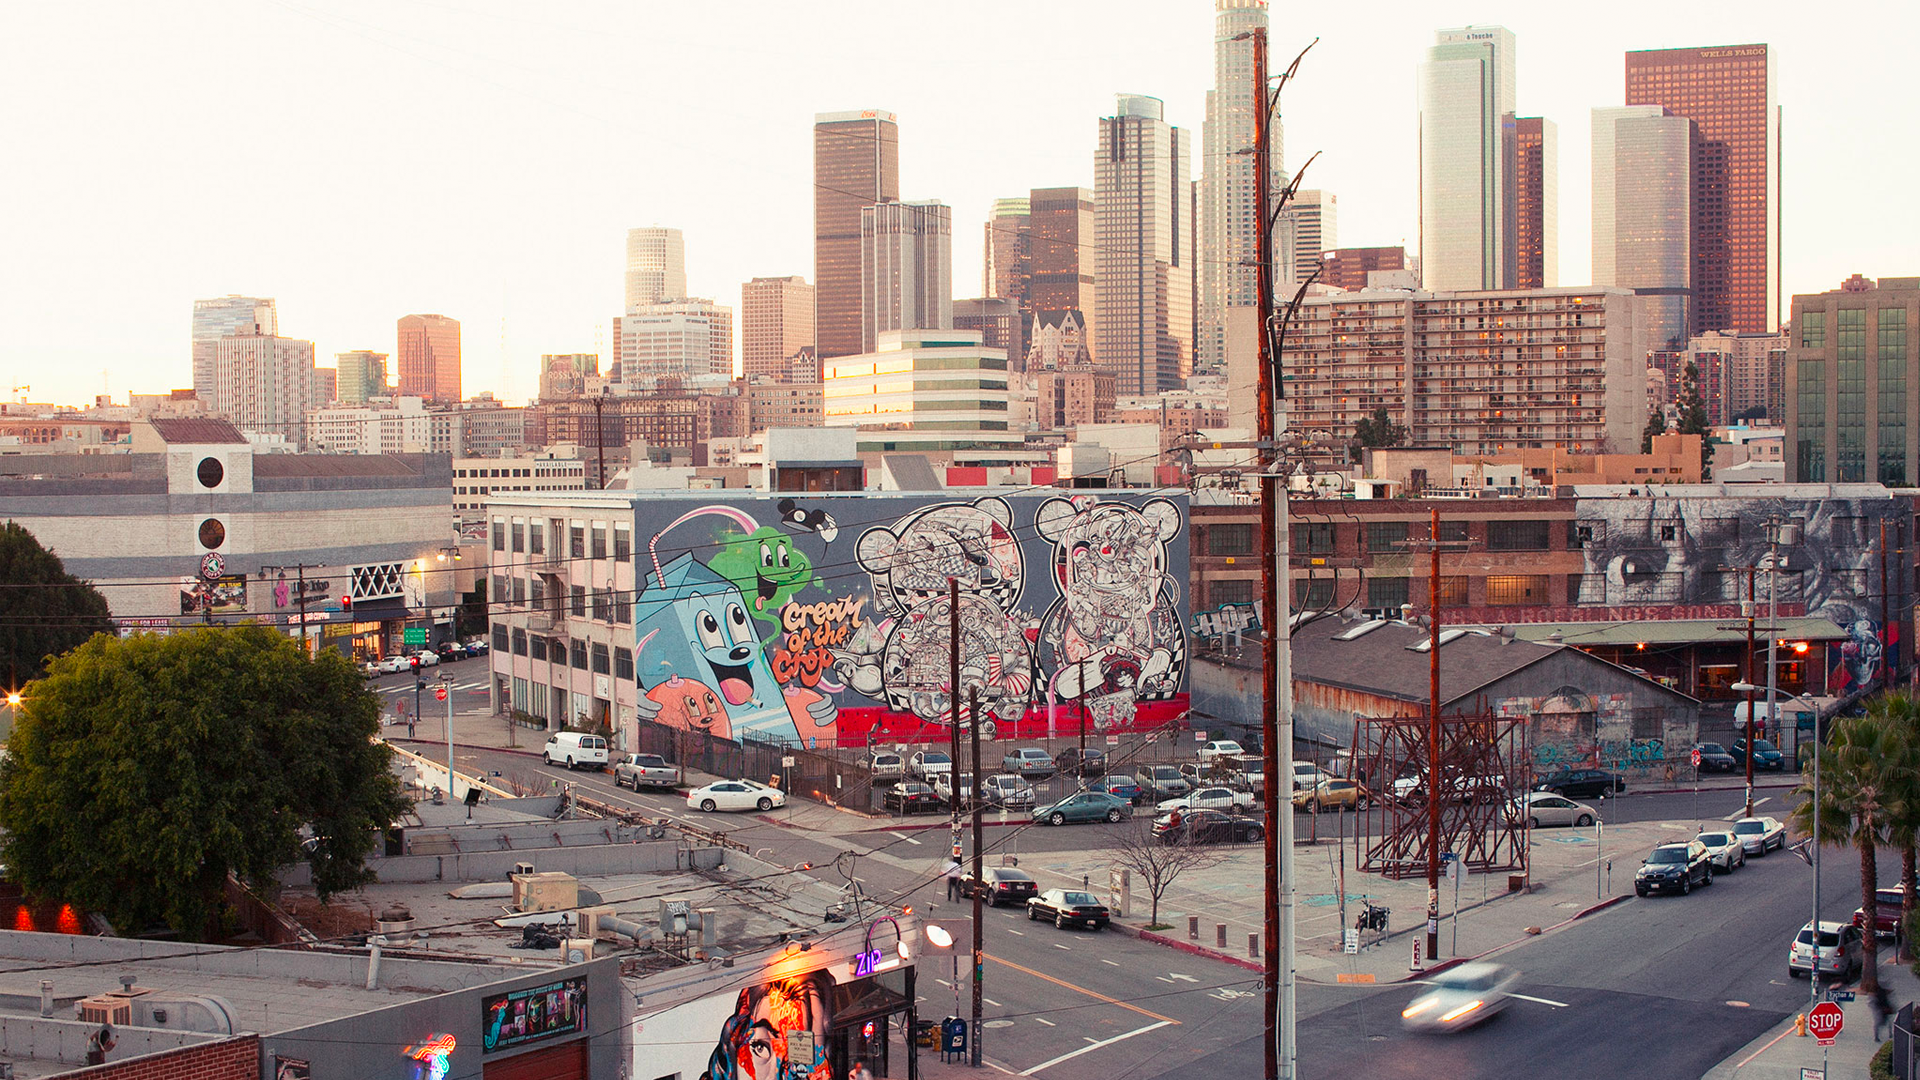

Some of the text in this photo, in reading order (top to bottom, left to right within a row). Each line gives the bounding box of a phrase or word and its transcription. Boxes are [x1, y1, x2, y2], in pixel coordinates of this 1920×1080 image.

[1700, 48, 1766, 58] WELLS FARGO
[548, 371, 581, 379] ROSSLYN
[812, 620, 848, 647] the
[855, 948, 883, 977] ZIP
[1811, 1013, 1842, 1029] STOP
